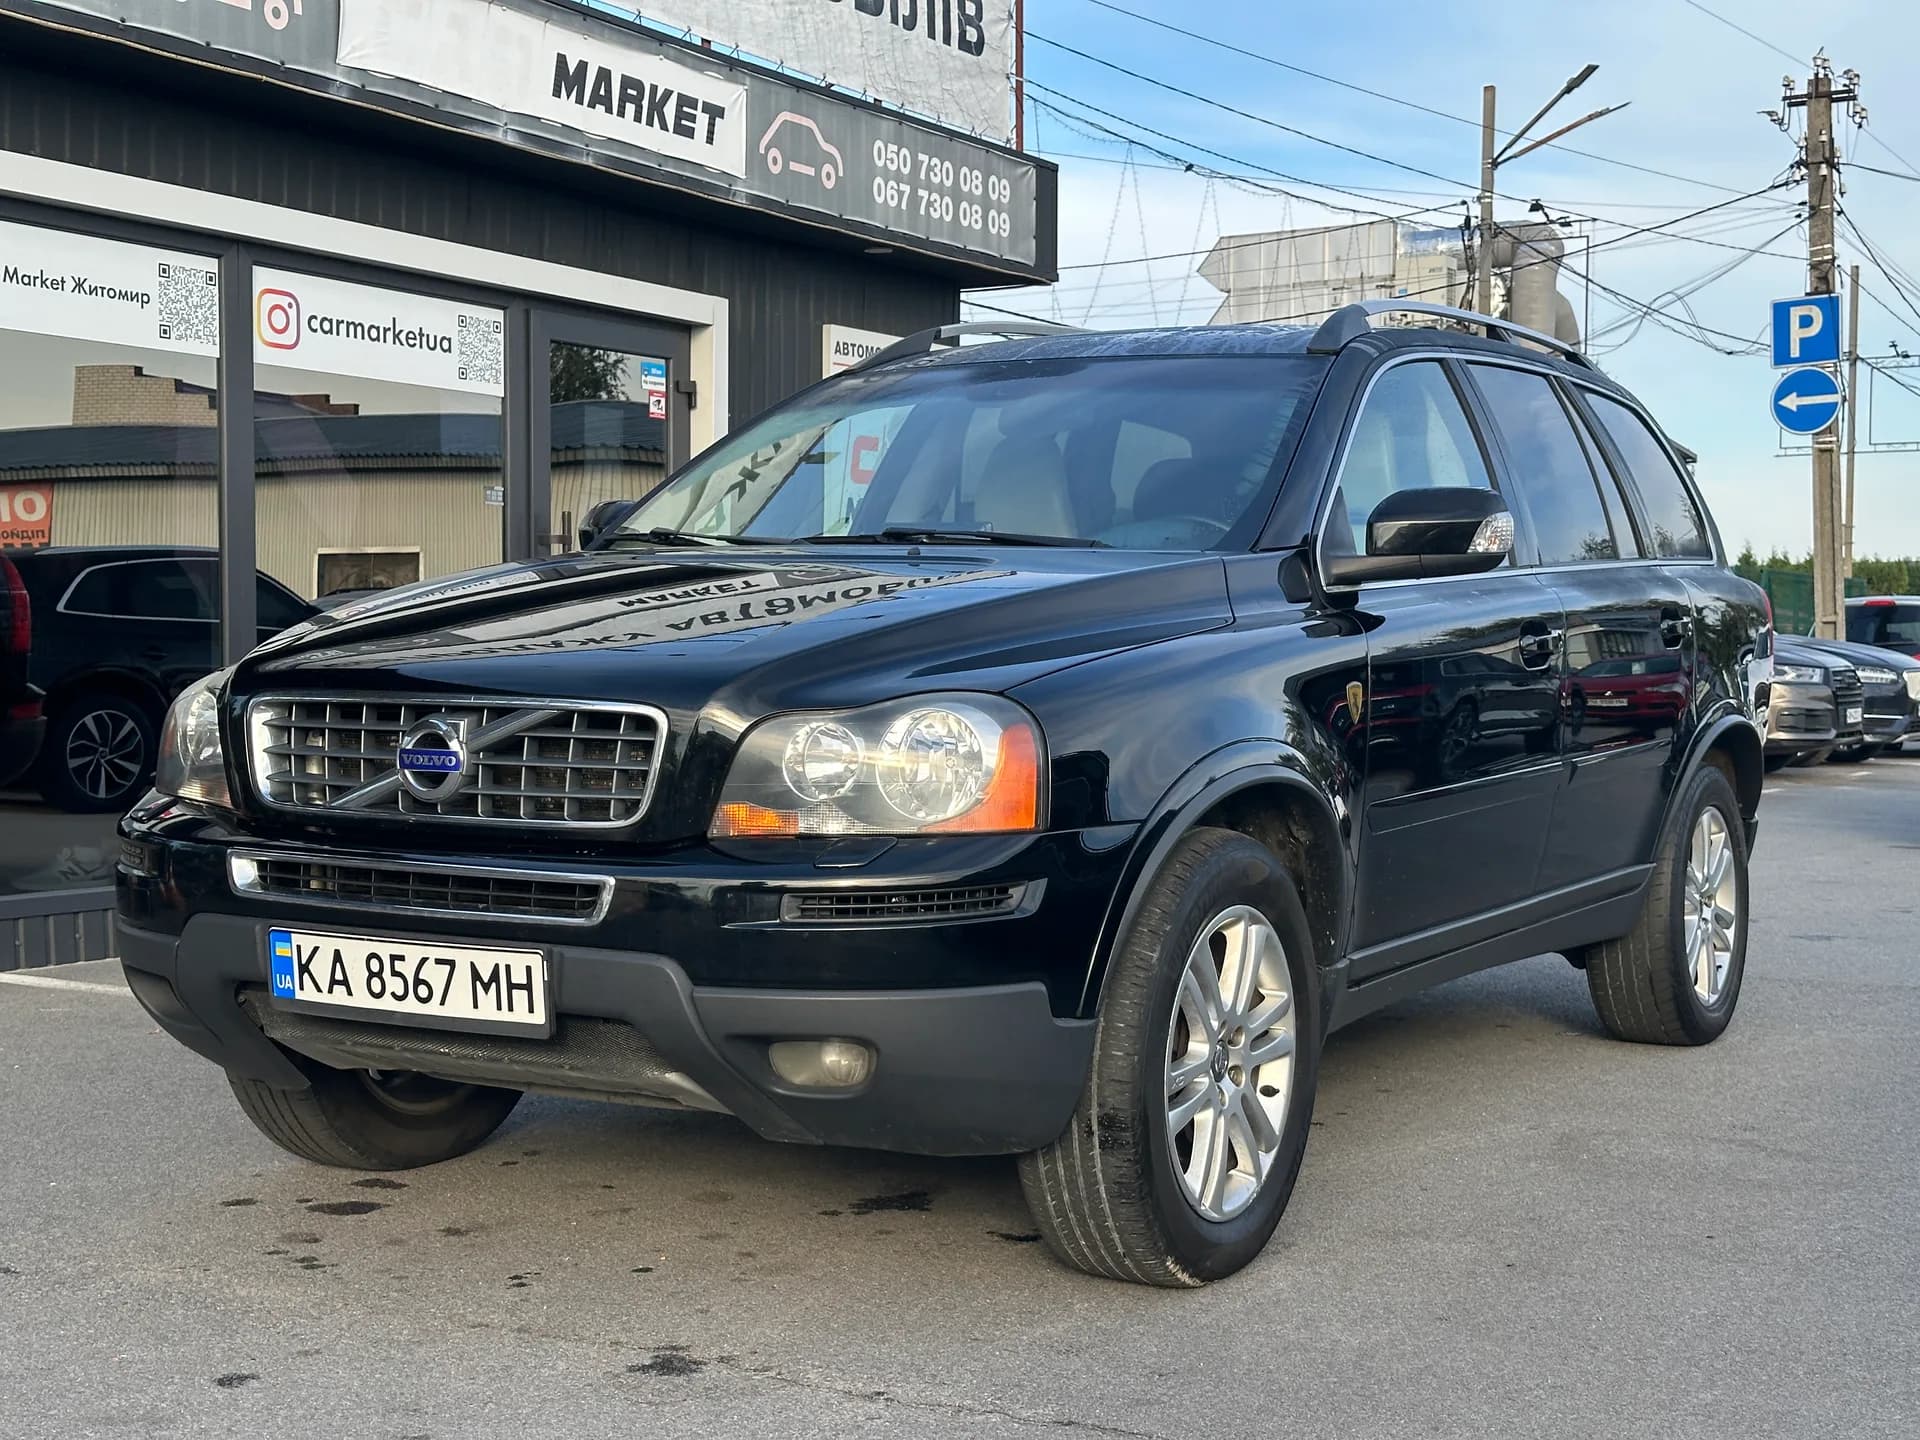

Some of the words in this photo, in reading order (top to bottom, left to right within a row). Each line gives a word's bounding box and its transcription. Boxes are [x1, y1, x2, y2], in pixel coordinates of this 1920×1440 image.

[552, 53, 725, 146] MARKET
[873, 140, 912, 175] 050
[917, 152, 954, 187] 730
[960, 166, 982, 196] 08
[988, 174, 1010, 204] 09
[873, 176, 910, 210] 067
[917, 188, 954, 222] 730
[960, 200, 982, 230] 08
[988, 208, 1010, 238] 09
[3, 265, 67, 293] Market
[70, 276, 151, 307] Житомир
[307, 312, 453, 354] carmarketua
[1790, 304, 1823, 358] P
[401, 752, 458, 768] VOLVO
[277, 973, 294, 991] UA
[296, 944, 353, 996] KA
[365, 951, 457, 1006] 8567
[470, 961, 535, 1014] MH
